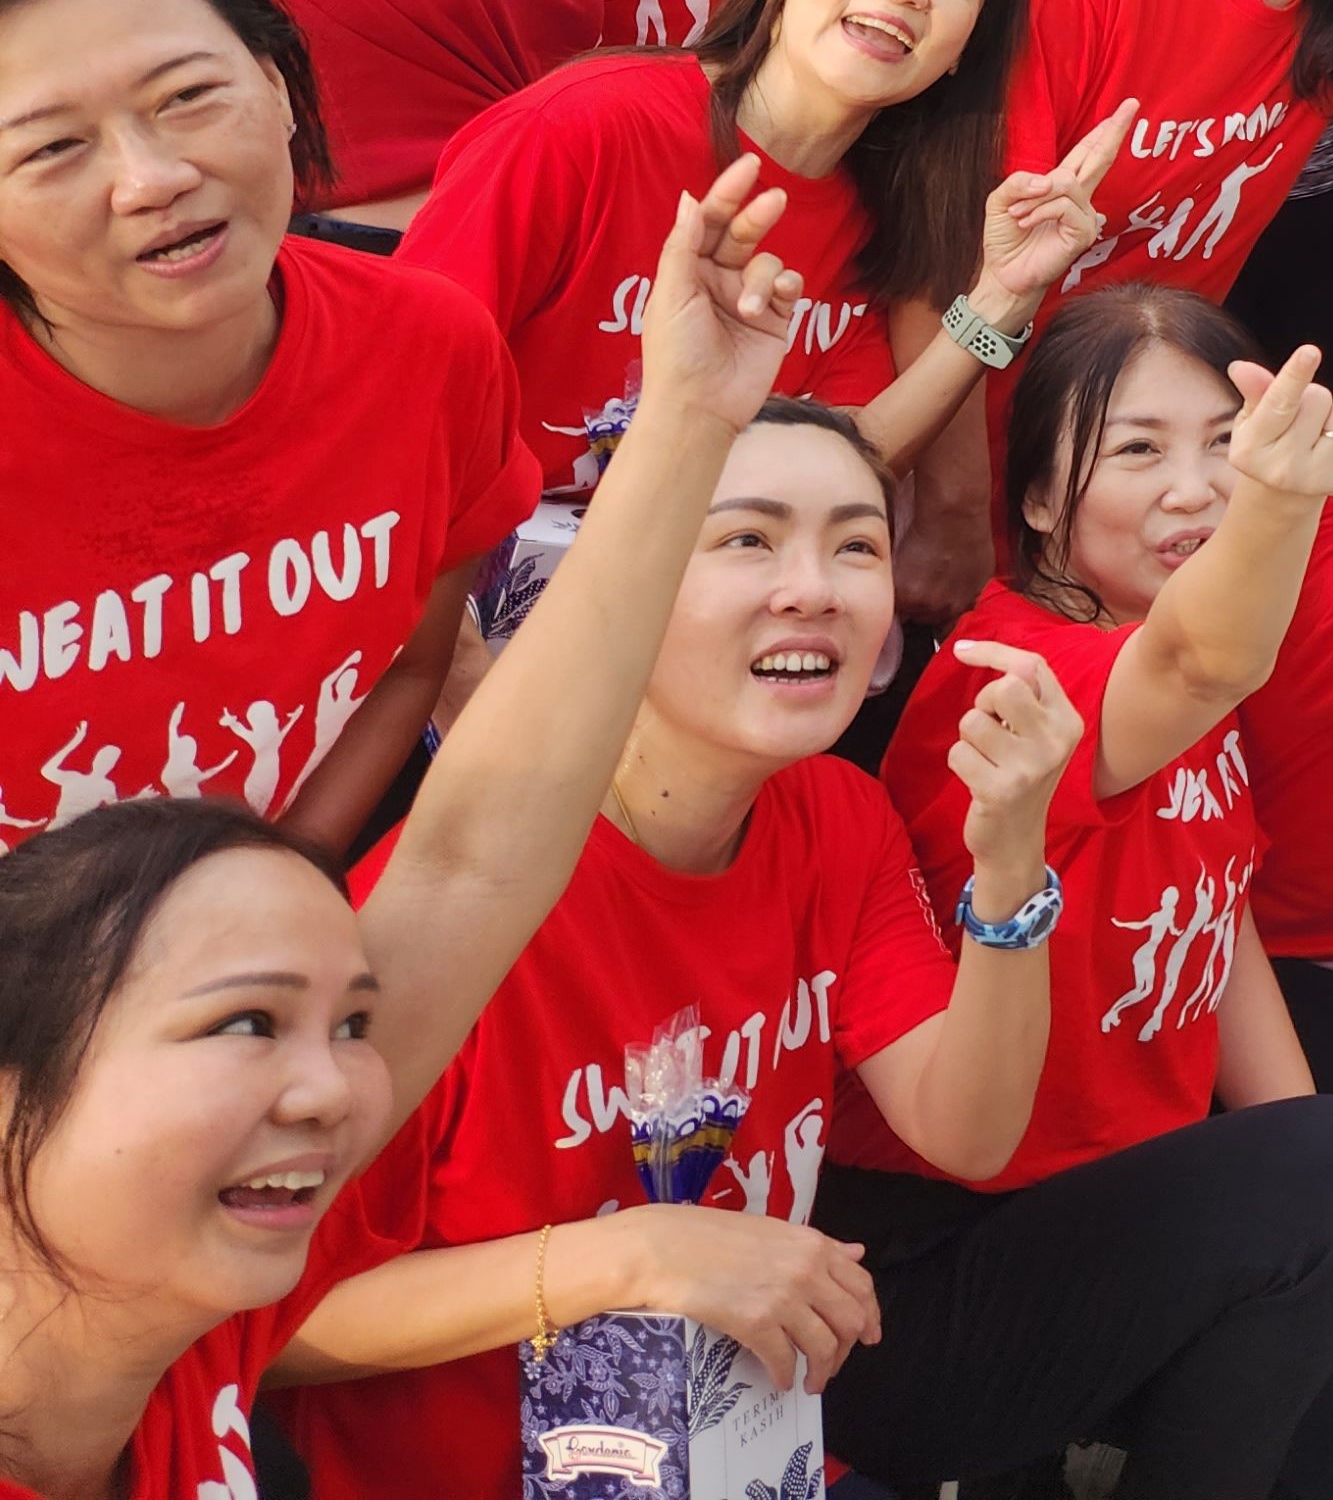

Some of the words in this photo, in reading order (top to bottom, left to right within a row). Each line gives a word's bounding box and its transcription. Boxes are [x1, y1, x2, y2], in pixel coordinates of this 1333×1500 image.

[1131, 99, 1216, 161] LET'S
[191, 552, 250, 643] IT
[268, 510, 400, 616] OUT
[733, 1389, 785, 1432] TERIM
[740, 1404, 783, 1448] KASIH
[566, 1436, 637, 1460] Gardenia
